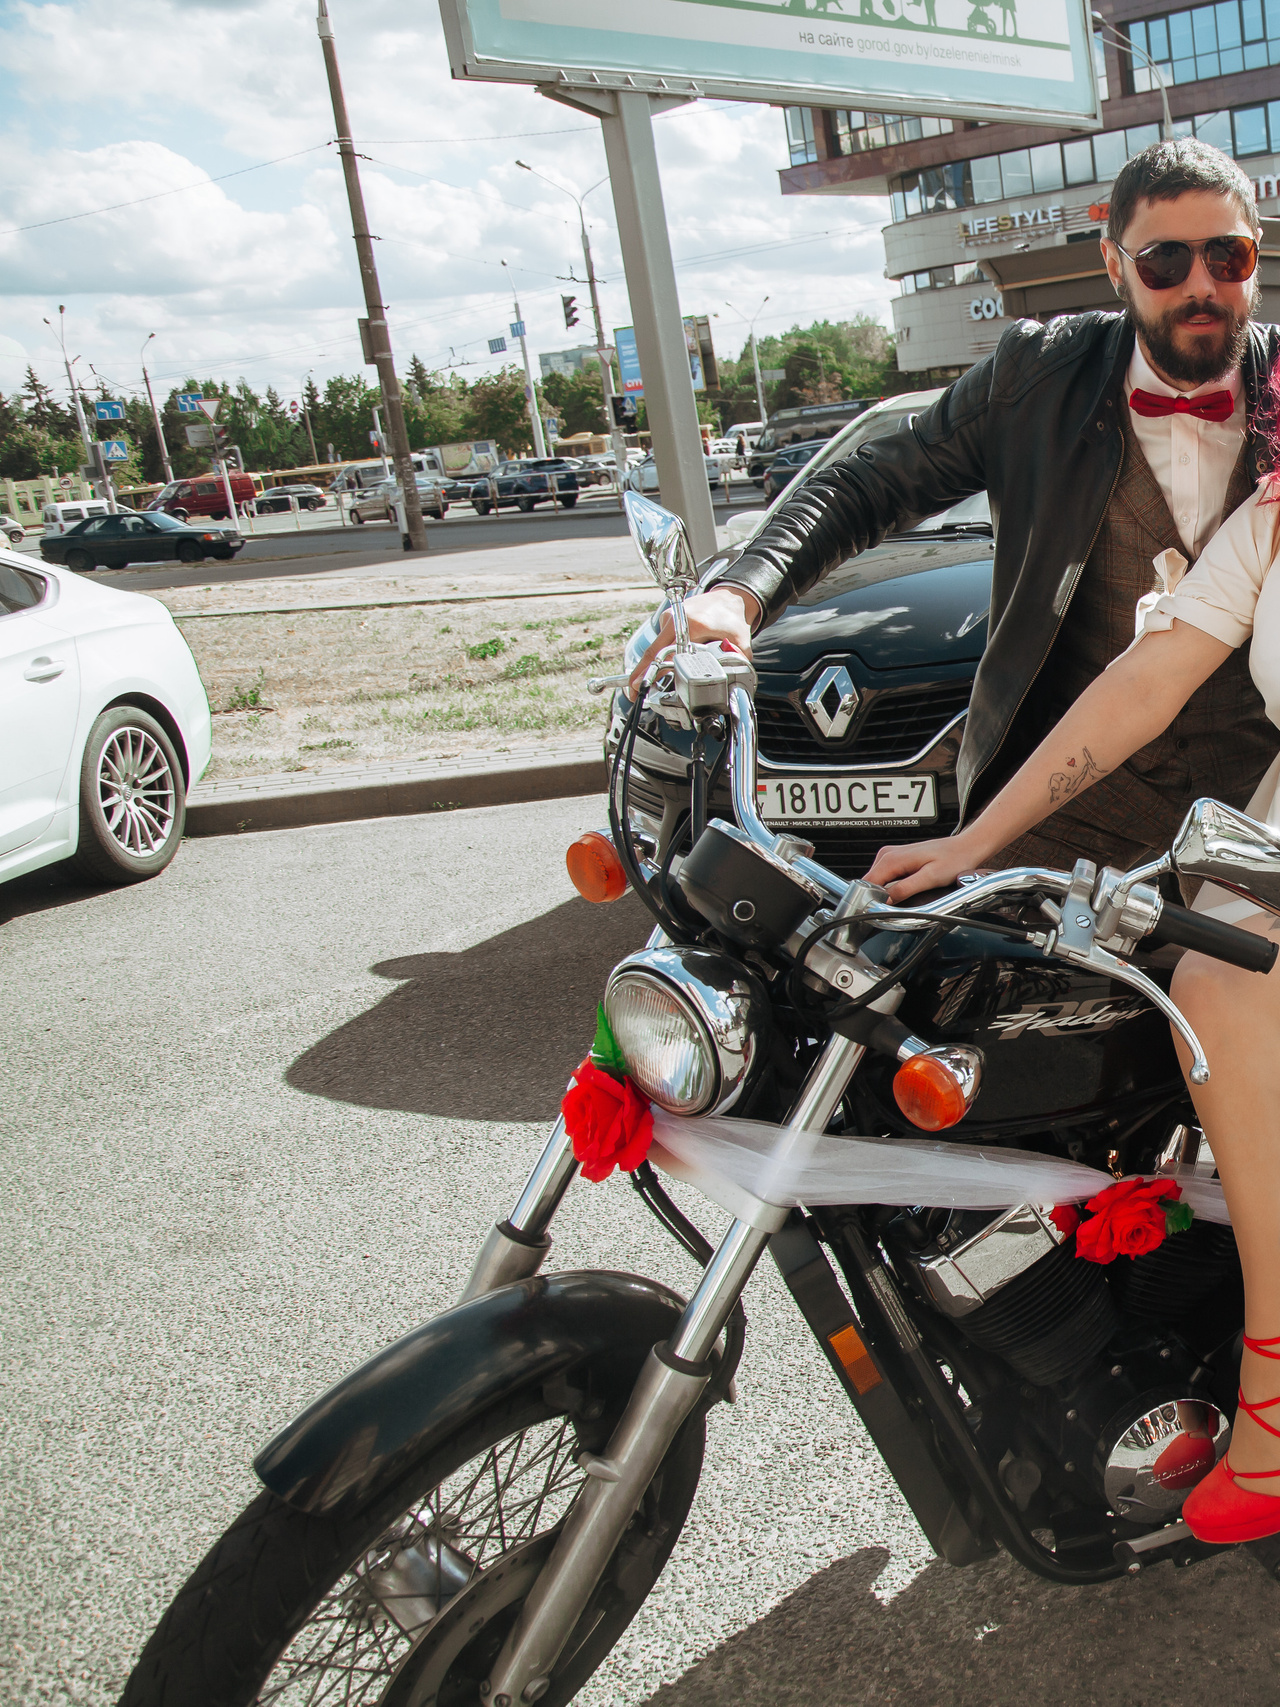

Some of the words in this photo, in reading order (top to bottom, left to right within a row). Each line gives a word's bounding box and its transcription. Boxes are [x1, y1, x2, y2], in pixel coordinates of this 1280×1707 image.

[798, 31, 815, 44] на
[818, 32, 854, 49] сайте
[857, 38, 1022, 67] gorod.gov.by/ozelenenie/minsk
[958, 206, 1062, 237] LIFESTYLE
